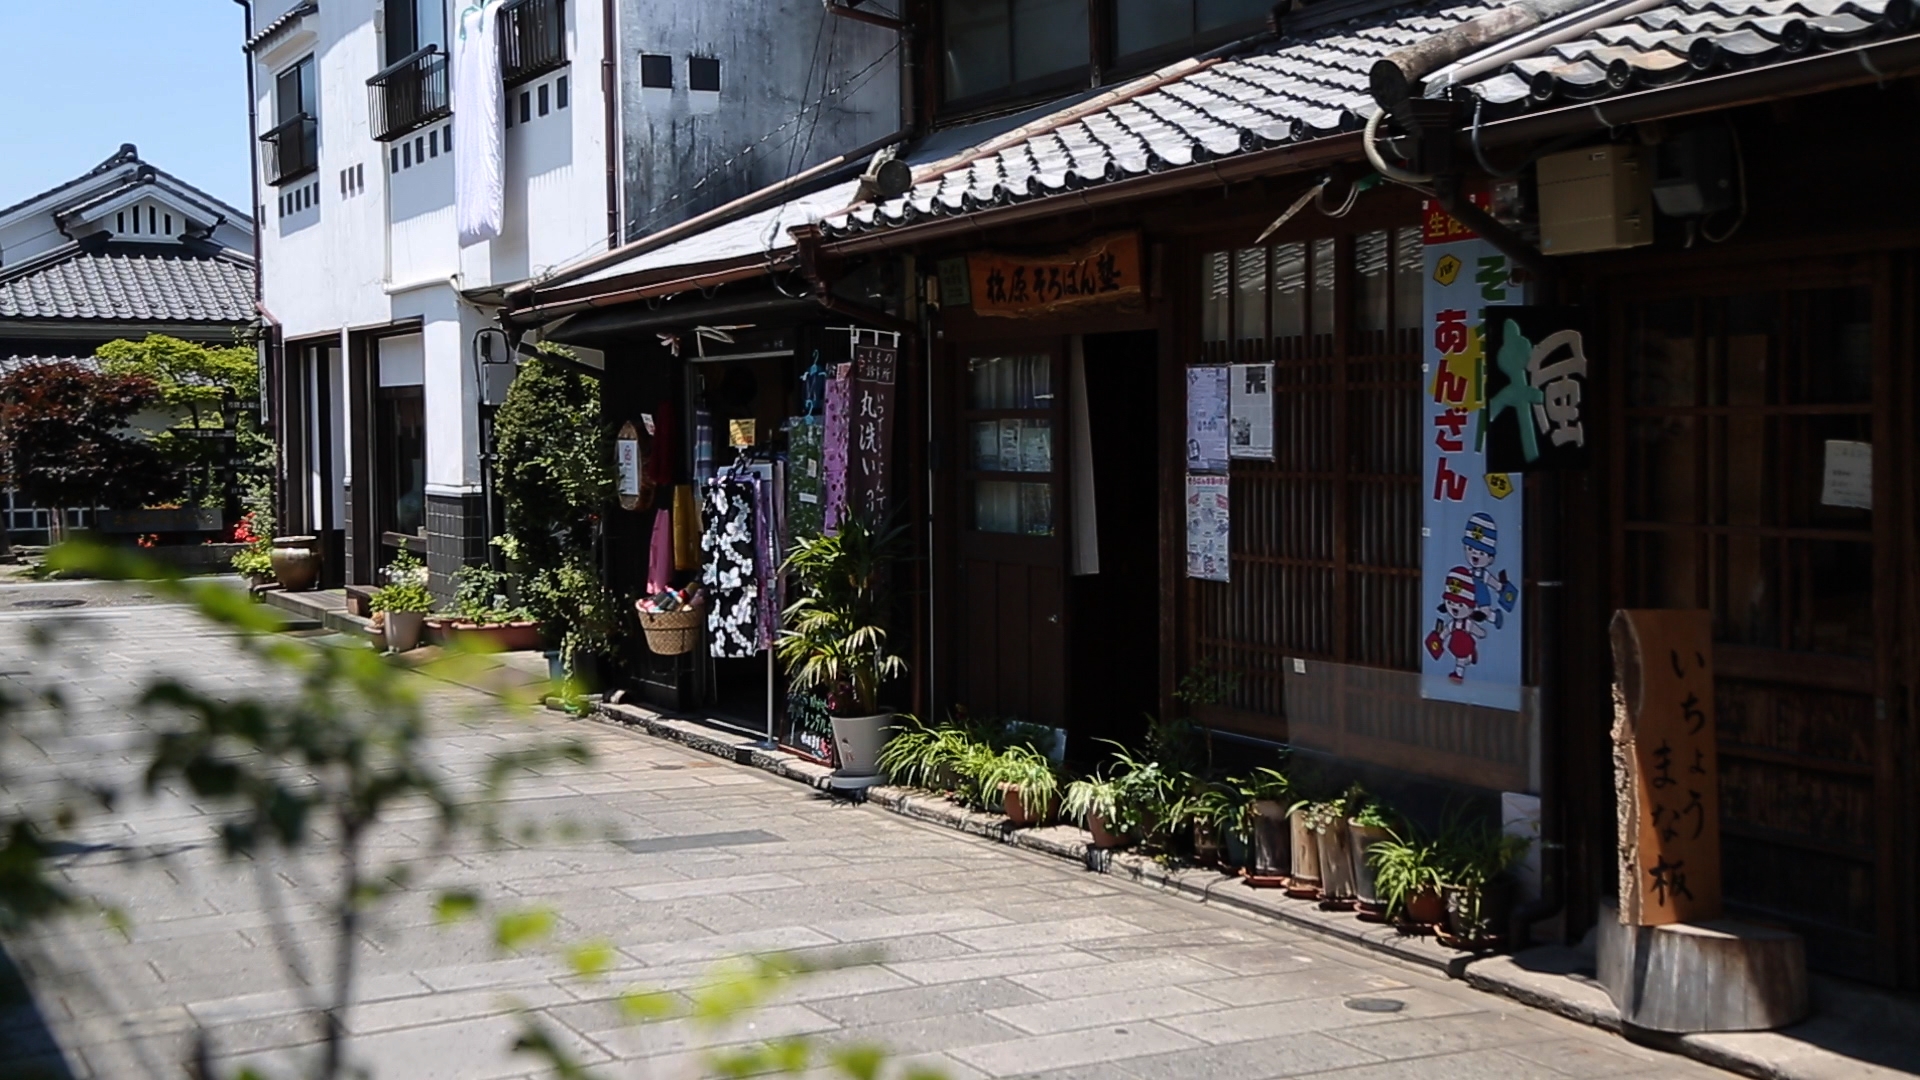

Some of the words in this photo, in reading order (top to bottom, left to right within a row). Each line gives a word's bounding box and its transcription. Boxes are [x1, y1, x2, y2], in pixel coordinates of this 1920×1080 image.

[859, 389, 878, 476] 丸洗い
[1434, 309, 1468, 502] あんざん
[1648, 739, 1694, 908] まな板
[1670, 650, 1706, 840] いちょう
